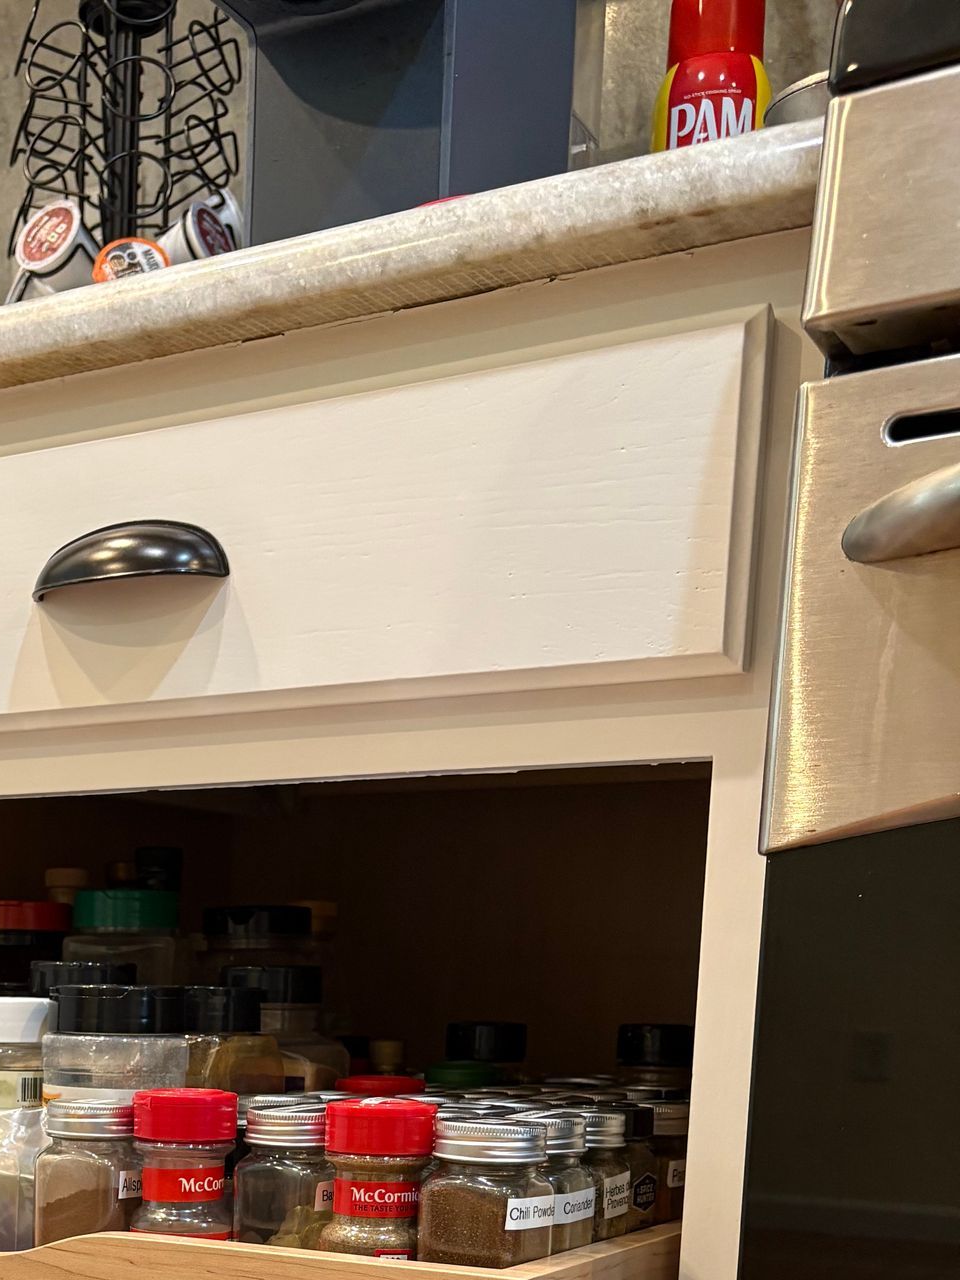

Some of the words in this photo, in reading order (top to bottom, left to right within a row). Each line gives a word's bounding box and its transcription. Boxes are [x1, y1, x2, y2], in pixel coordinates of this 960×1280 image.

[669, 97, 753, 149] PAM
[605, 1183, 625, 1198] Herbes
[353, 1203, 368, 1212] THE
[371, 1205, 393, 1213] TASTE
[509, 1204, 531, 1221] Chili
[563, 1197, 593, 1215] Coriander
